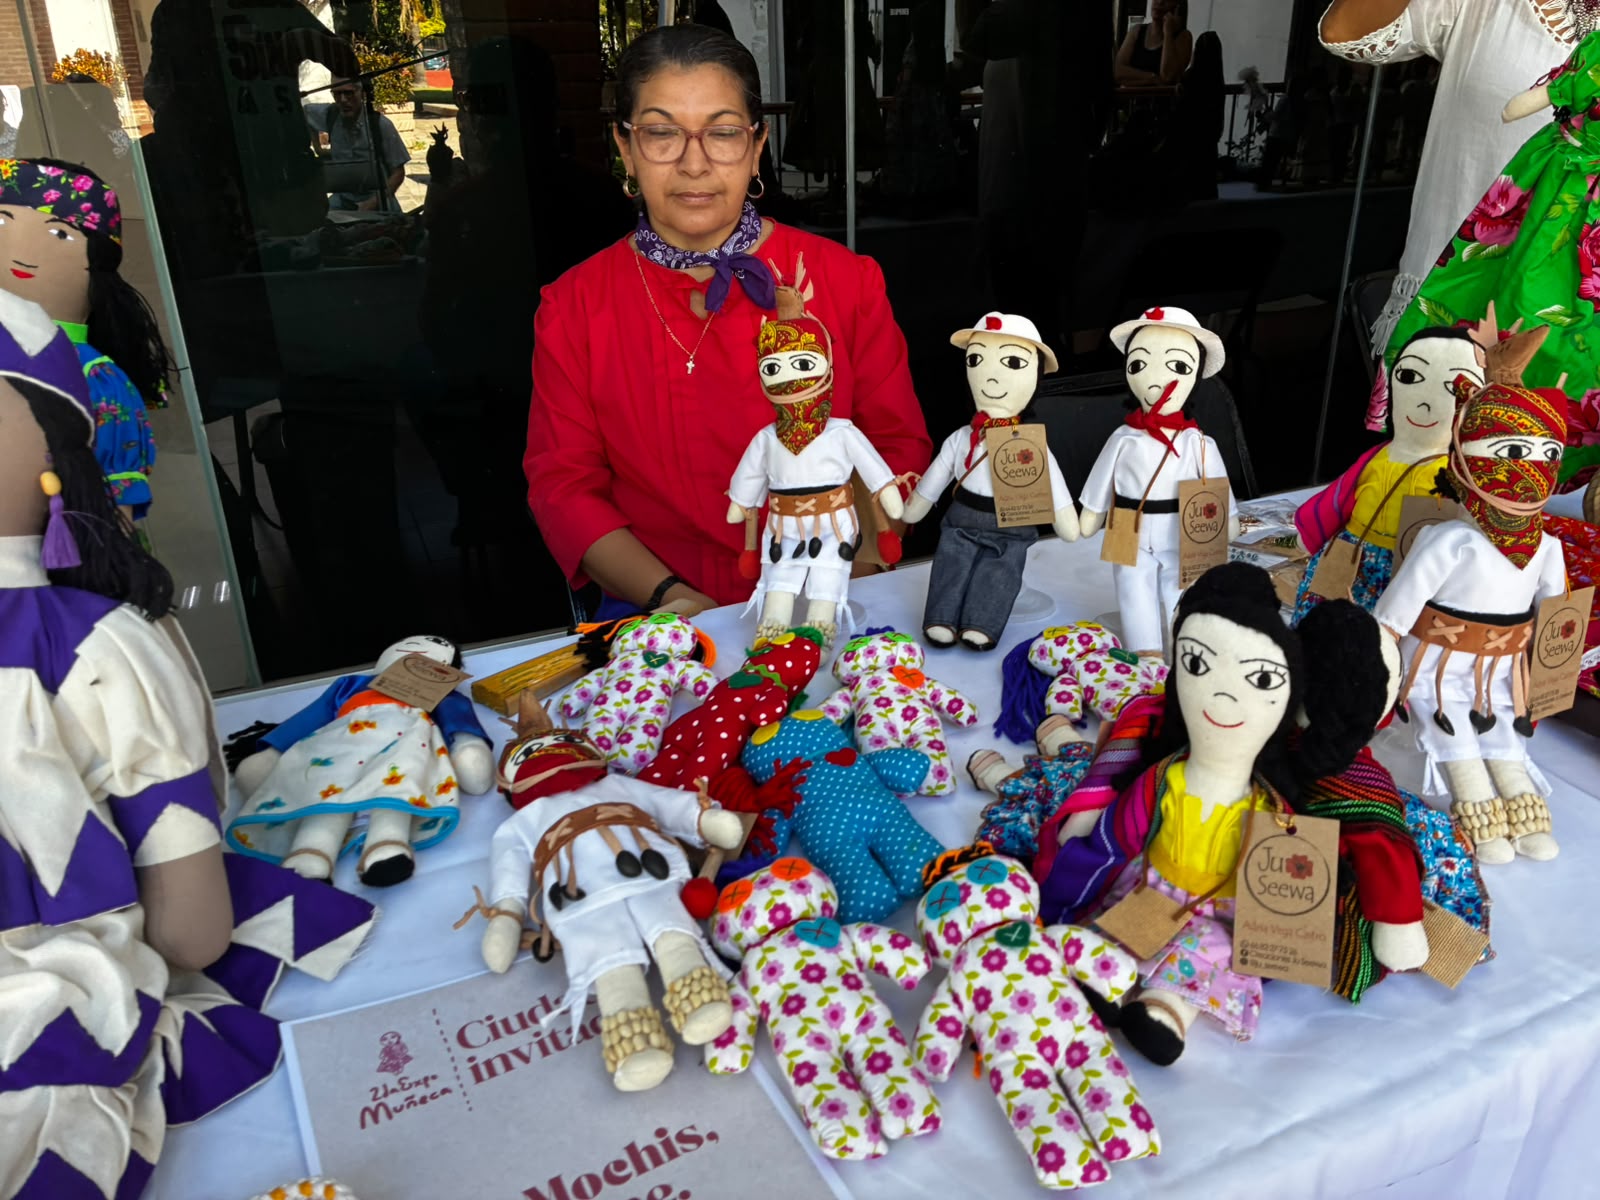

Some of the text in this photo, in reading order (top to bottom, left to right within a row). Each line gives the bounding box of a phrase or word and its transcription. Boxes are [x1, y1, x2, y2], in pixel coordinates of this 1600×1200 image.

[1000, 448, 1017, 466] Ju
[1002, 466, 1038, 480] Seewa
[1189, 501, 1203, 519] Ju
[1189, 520, 1219, 534] Seewa
[1544, 620, 1561, 642] Ju
[1543, 640, 1574, 660] Seewa
[1257, 846, 1284, 873] Ju
[1257, 875, 1315, 904] Seewa
[360, 1088, 453, 1129] Muñeca
